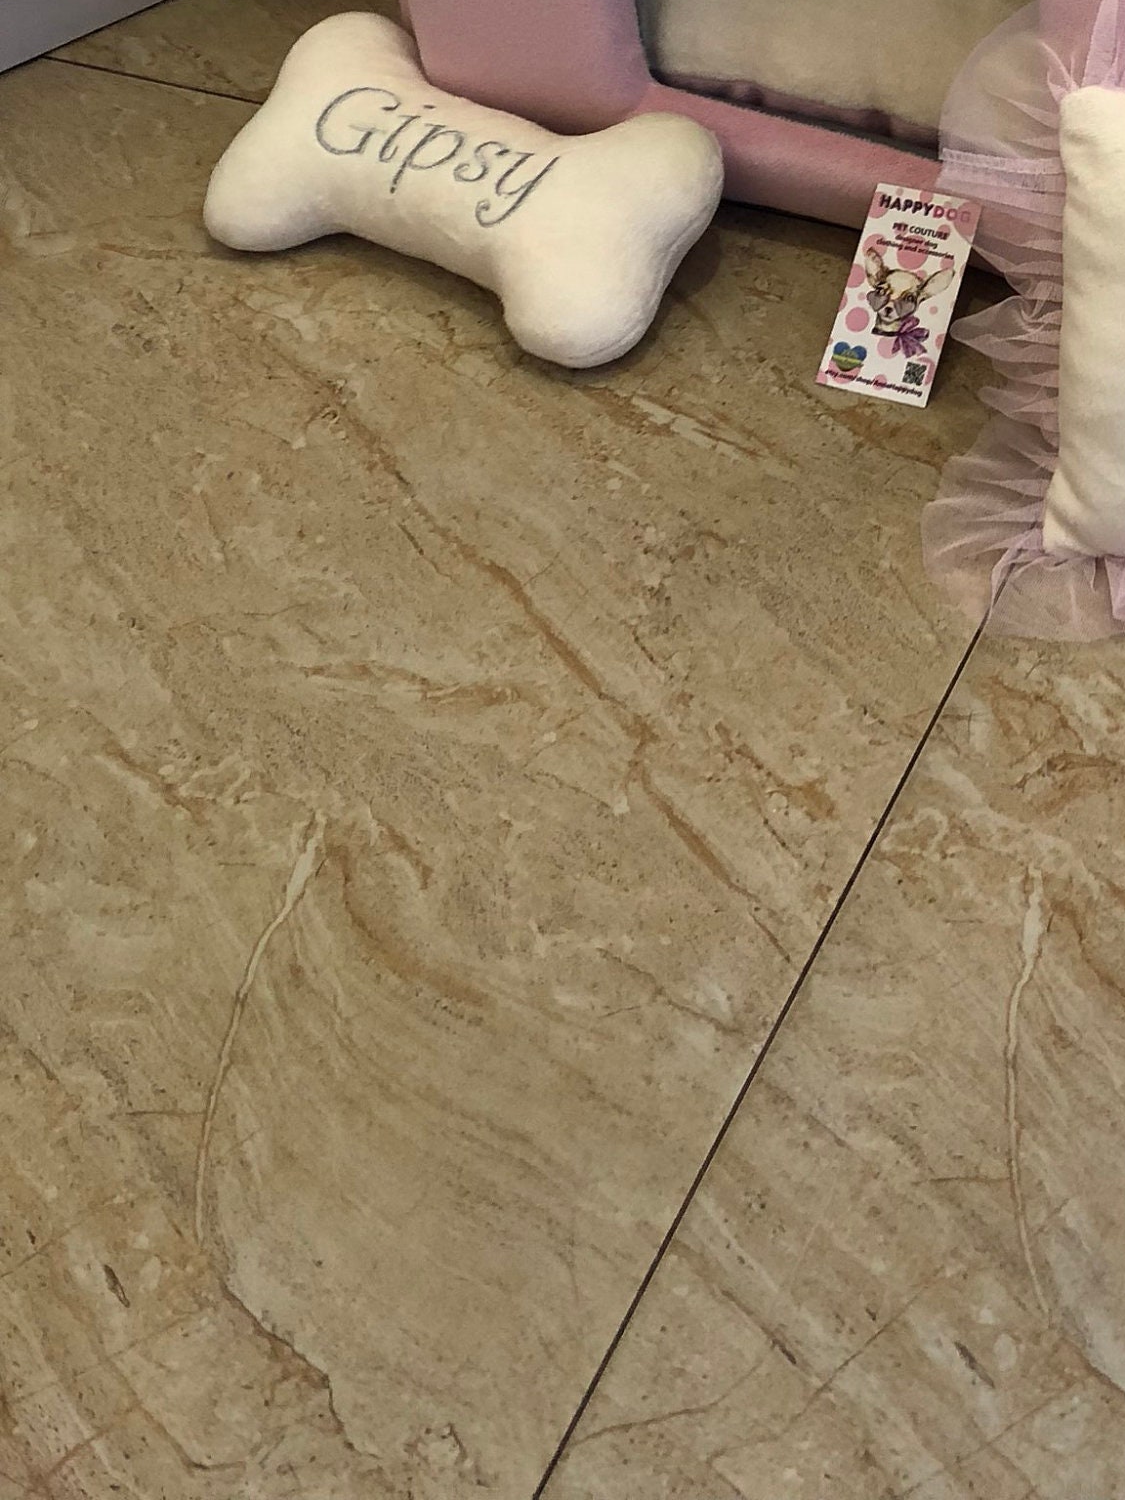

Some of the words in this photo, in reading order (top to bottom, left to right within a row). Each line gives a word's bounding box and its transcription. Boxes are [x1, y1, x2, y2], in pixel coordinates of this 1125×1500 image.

[314, 86, 561, 228] Gipsy
[892, 222, 908, 232] PET
[909, 226, 949, 240] COUTURE
